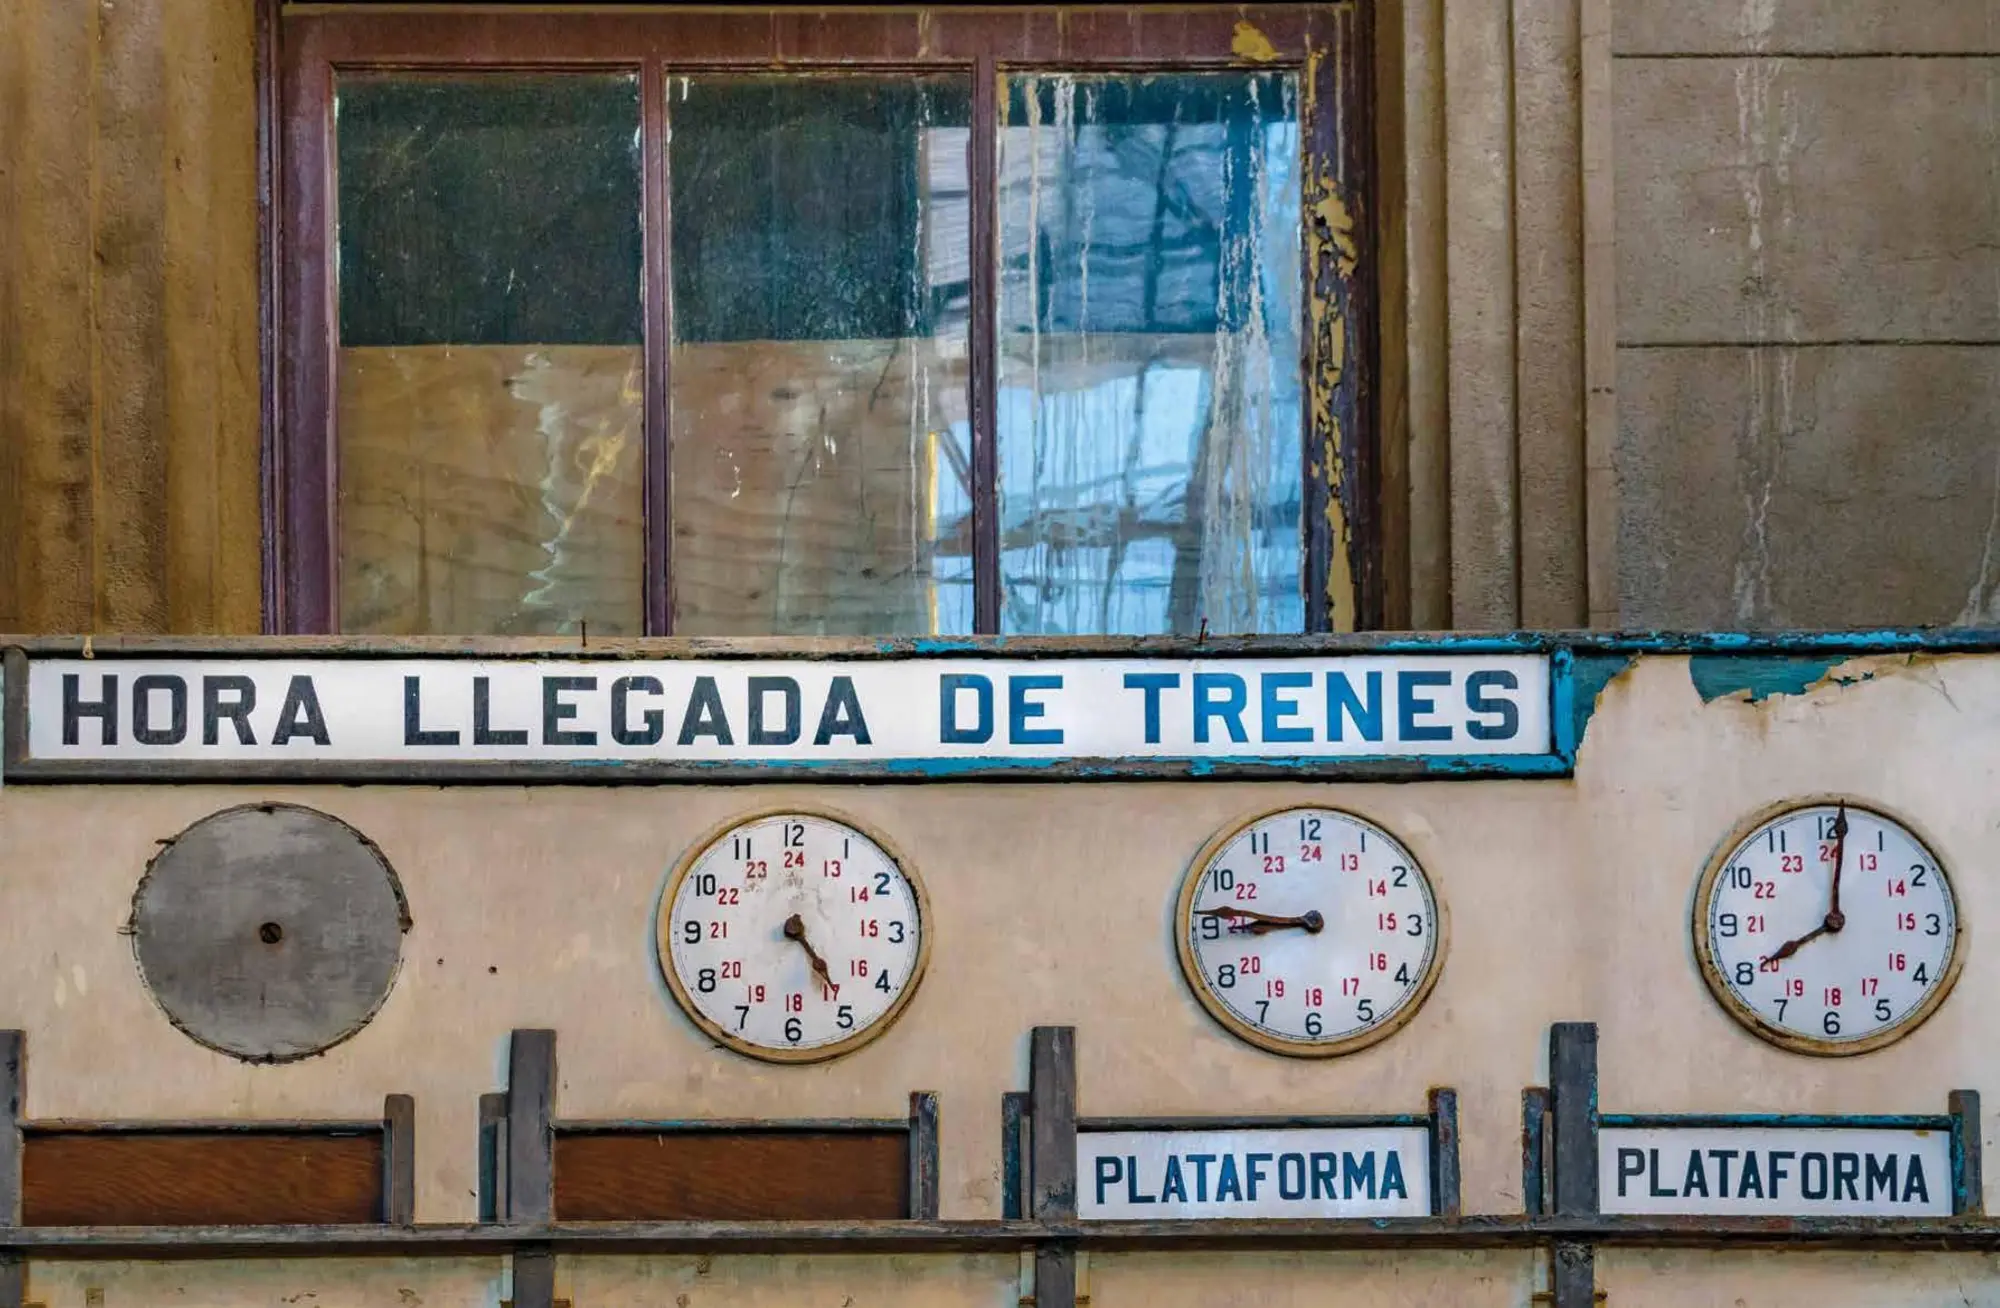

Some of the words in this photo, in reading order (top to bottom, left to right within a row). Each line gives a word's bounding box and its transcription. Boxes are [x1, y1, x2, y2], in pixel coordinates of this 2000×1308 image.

[62, 674, 331, 746] HORA
[404, 675, 872, 746] LLEGADA
[940, 673, 1064, 744] DE
[1124, 670, 1519, 743] TRENES
[785, 824, 805, 847] 12
[1300, 819, 1321, 841] 12
[734, 838, 751, 860] 11
[844, 838, 849, 859] 1
[1251, 832, 1268, 854] 11
[1361, 832, 1365, 853] 1
[1769, 829, 1785, 853] 11
[1879, 830, 1883, 852] 1
[784, 852, 805, 868] 24
[1301, 845, 1321, 862] 24
[1341, 854, 1358, 871] 13
[1860, 854, 1877, 871] 13
[746, 861, 767, 878] 23
[823, 861, 841, 878] 13
[1264, 856, 1285, 873] 23
[1782, 856, 1803, 873] 23
[695, 874, 716, 897] 10
[874, 873, 890, 895] 2
[1213, 869, 1234, 892] 10
[1392, 866, 1408, 887] 2
[1731, 867, 1751, 889] 10
[1910, 864, 1926, 887] 2
[718, 888, 739, 905] 22
[851, 886, 869, 903] 14
[1236, 883, 1257, 900] 22
[1369, 879, 1386, 896] 14
[1754, 882, 1776, 899] 22
[1888, 880, 1905, 897] 14
[684, 920, 701, 944] 9
[710, 921, 727, 939] 21
[860, 920, 878, 937] 15
[888, 921, 904, 943] 3
[1202, 916, 1219, 940] 9
[1379, 913, 1397, 931] 15
[1407, 914, 1422, 936] 3
[1719, 913, 1737, 937] 9
[1747, 915, 1764, 932] 21
[1898, 913, 1916, 930] 15
[1925, 914, 1940, 936] 3
[721, 962, 741, 979] 20
[851, 960, 868, 977] 16
[1240, 956, 1260, 974] 20
[1369, 953, 1387, 971] 16
[1888, 953, 1906, 971] 16
[698, 969, 716, 993] 8
[875, 969, 891, 993] 4
[1218, 964, 1235, 988] 8
[1394, 962, 1410, 986] 4
[1735, 962, 1754, 985] 8
[1913, 962, 1929, 986] 4
[748, 985, 765, 1003] 19
[823, 984, 840, 1001] 17
[1267, 980, 1285, 998] 19
[1343, 978, 1360, 996] 17
[1786, 979, 1804, 997] 19
[1824, 988, 1841, 1006] 18
[1862, 978, 1878, 996] 17
[786, 994, 803, 1012] 18
[1305, 989, 1322, 1007] 18
[734, 1006, 750, 1030] 7
[836, 1005, 853, 1028] 5
[1255, 1000, 1270, 1024] 7
[1357, 999, 1373, 1022] 5
[1773, 999, 1788, 1022] 7
[1875, 999, 1891, 1021] 5
[785, 1018, 802, 1042] 6
[1305, 1012, 1322, 1036] 6
[1824, 1011, 1840, 1035] 6
[1094, 1149, 1408, 1205] PLATAFORMA
[1617, 1147, 1930, 1204] PLATAFORMA
